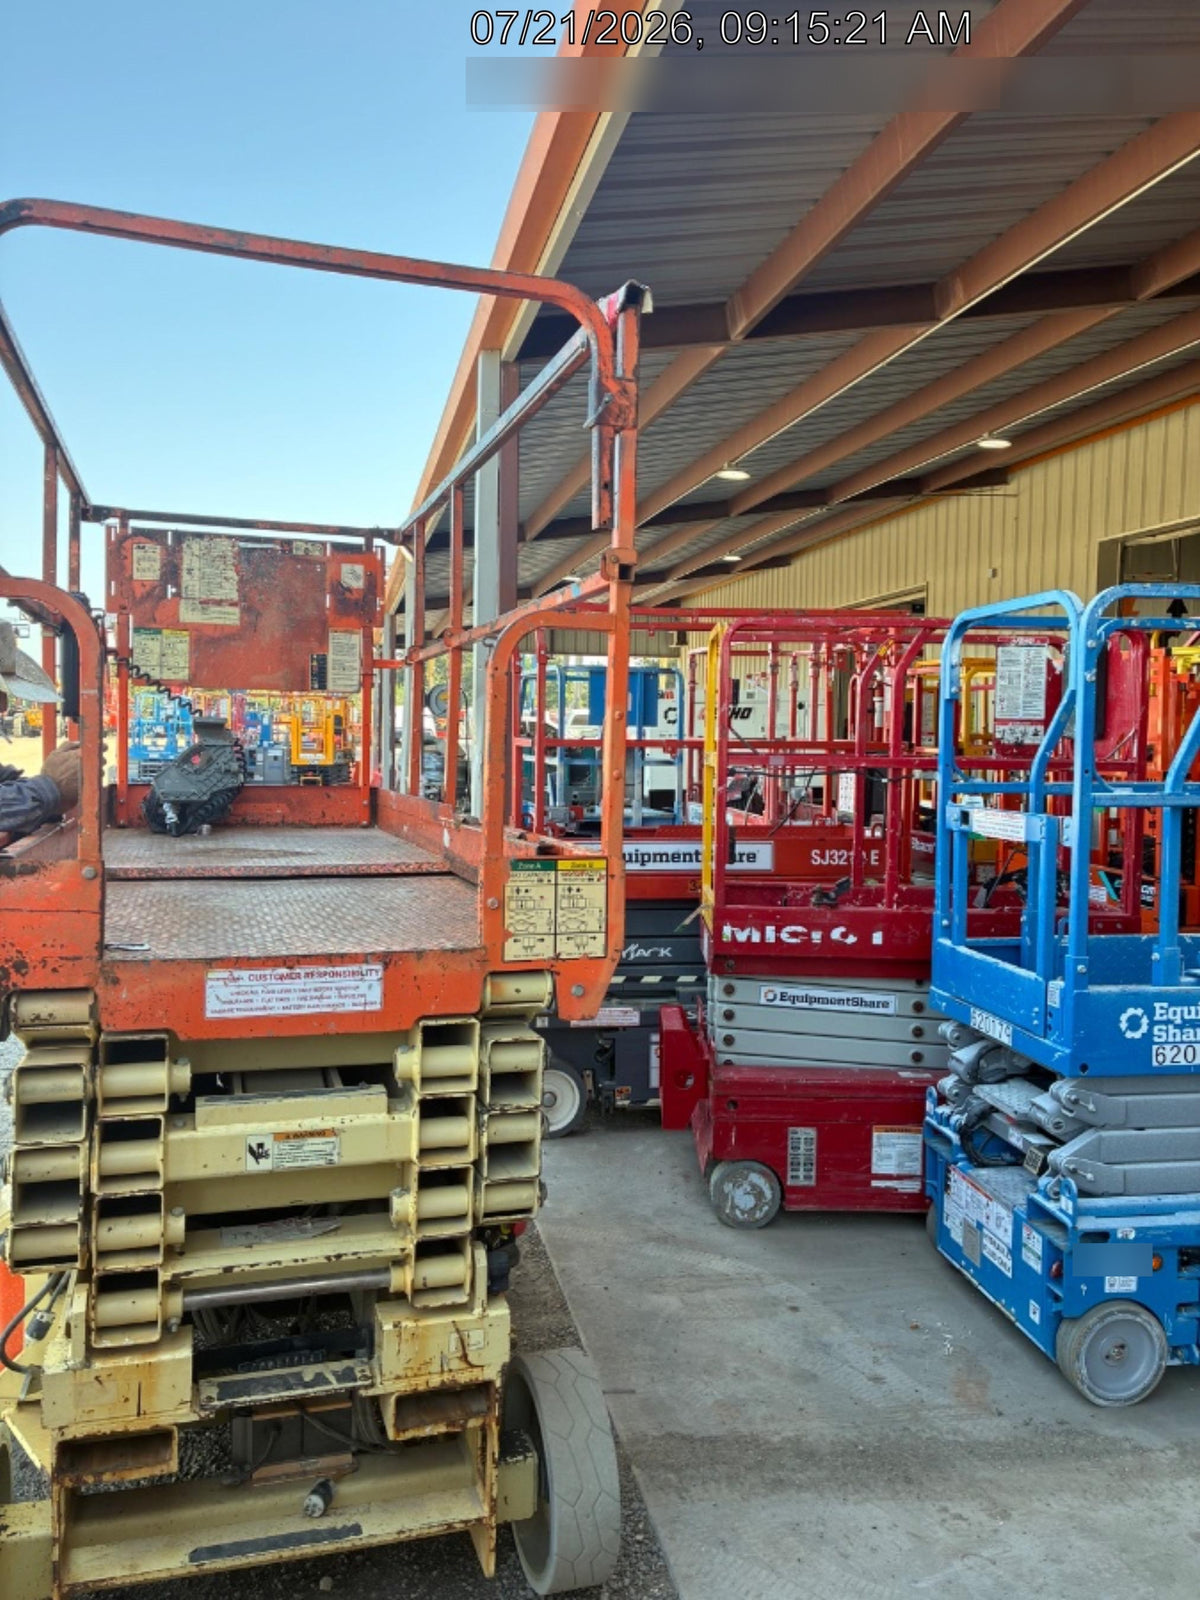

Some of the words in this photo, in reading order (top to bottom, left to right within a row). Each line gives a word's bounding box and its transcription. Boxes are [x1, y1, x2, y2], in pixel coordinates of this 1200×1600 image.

[248, 970, 302, 982] CUSTOMER
[779, 991, 890, 1009] EquipmentShare
[1154, 1044, 1196, 1066] 620
